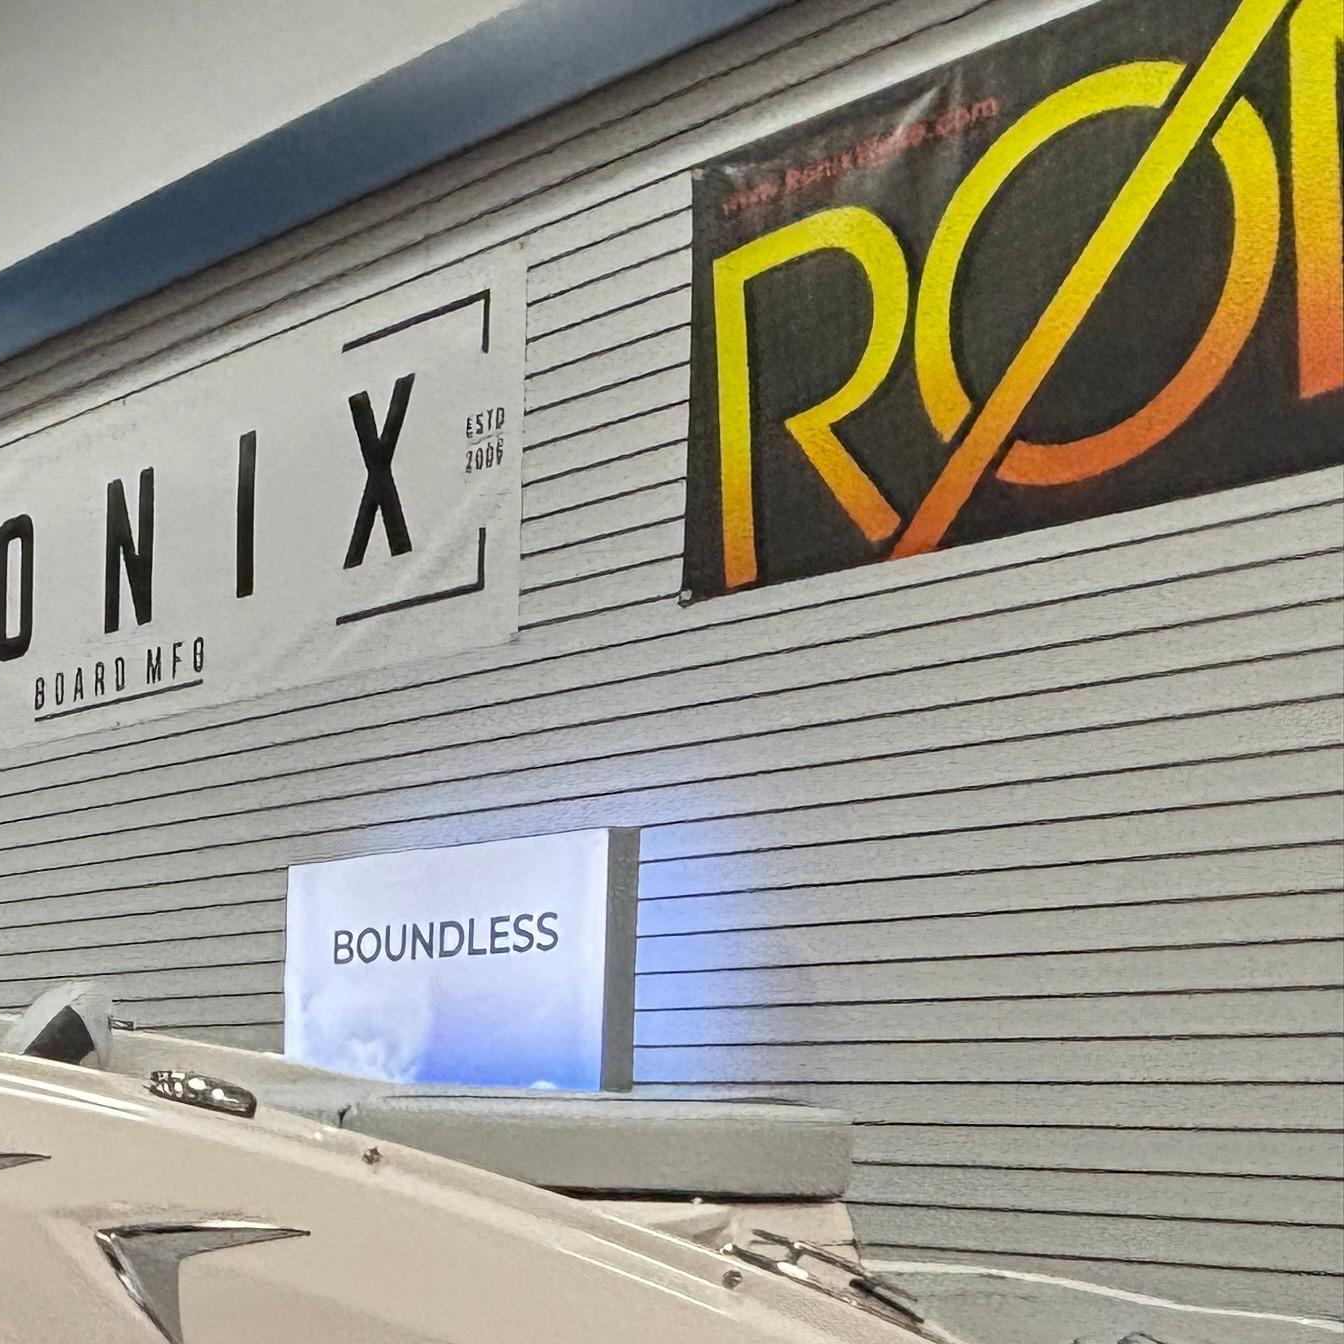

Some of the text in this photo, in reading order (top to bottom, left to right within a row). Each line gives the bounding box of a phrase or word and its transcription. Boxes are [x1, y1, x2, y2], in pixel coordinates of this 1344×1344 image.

[713, 0, 1344, 588] RØ
[465, 406, 505, 439] ESTD
[34, 636, 205, 711] BOARD MFG
[333, 911, 560, 965] BOUNDLESS
